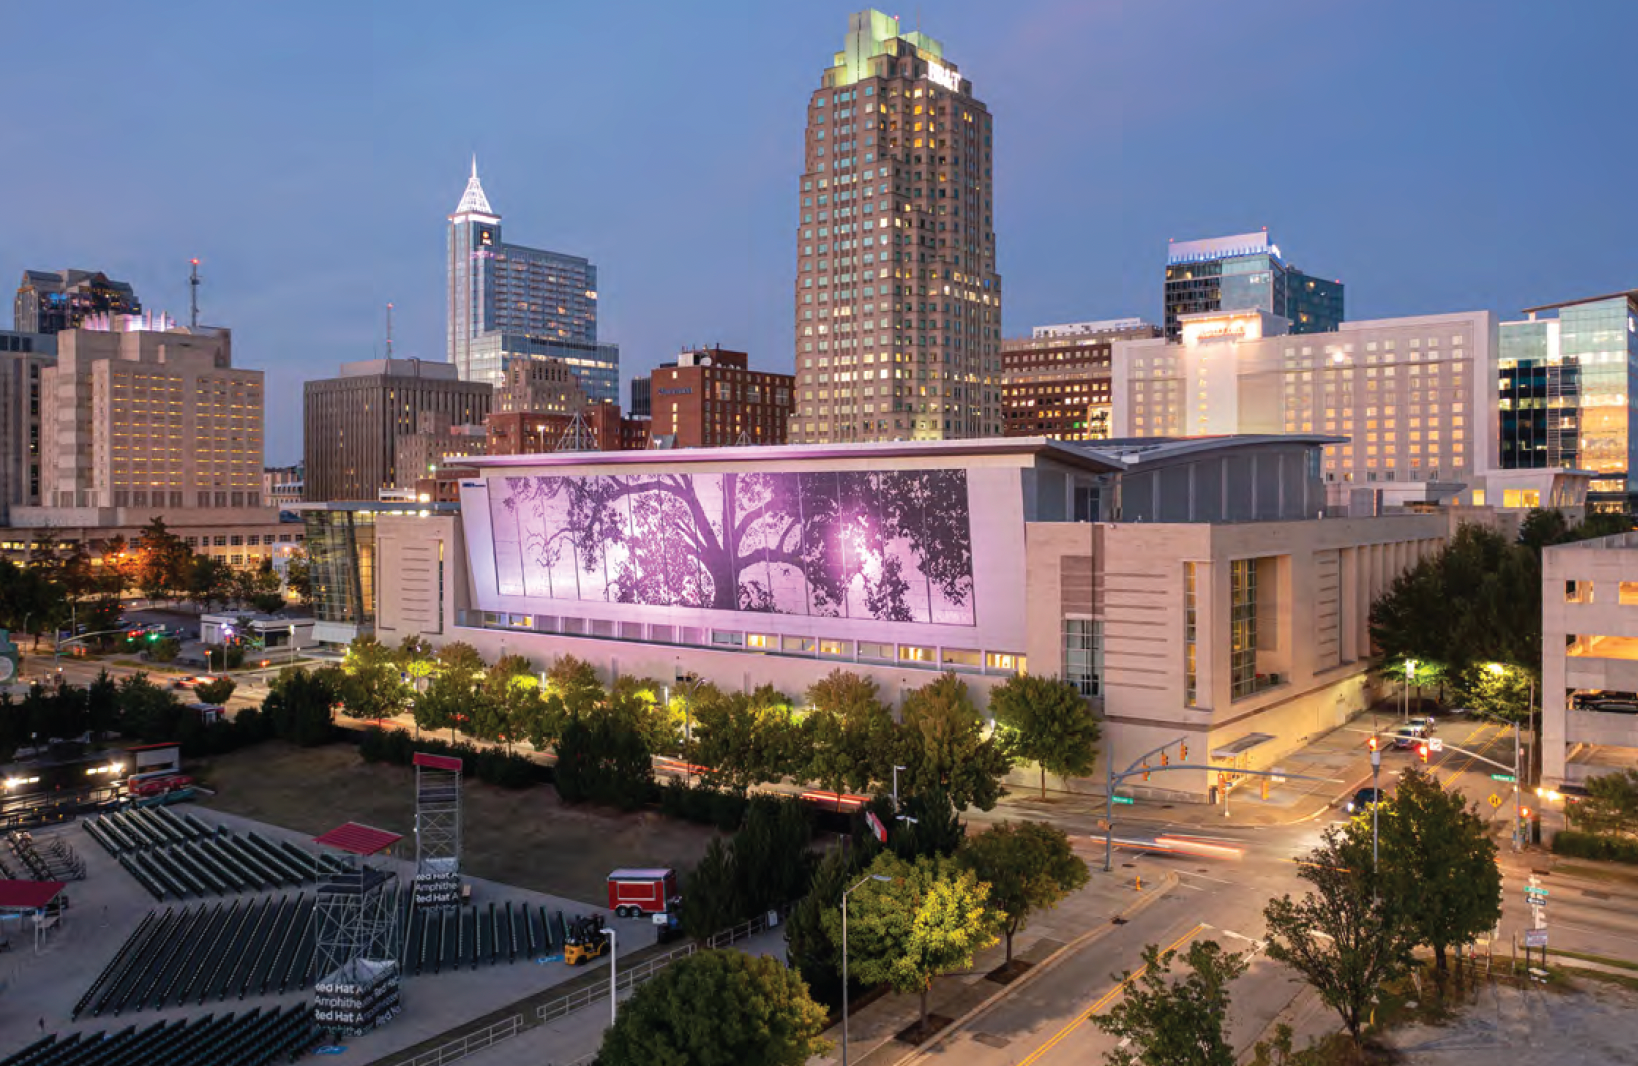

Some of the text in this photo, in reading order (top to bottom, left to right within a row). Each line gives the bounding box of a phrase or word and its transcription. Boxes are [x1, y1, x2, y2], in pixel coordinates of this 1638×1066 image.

[433, 893, 449, 901] Hat
[335, 984, 354, 994] Hat
[315, 995, 362, 1009] Amphithe
[335, 1011, 354, 1022] Hat
